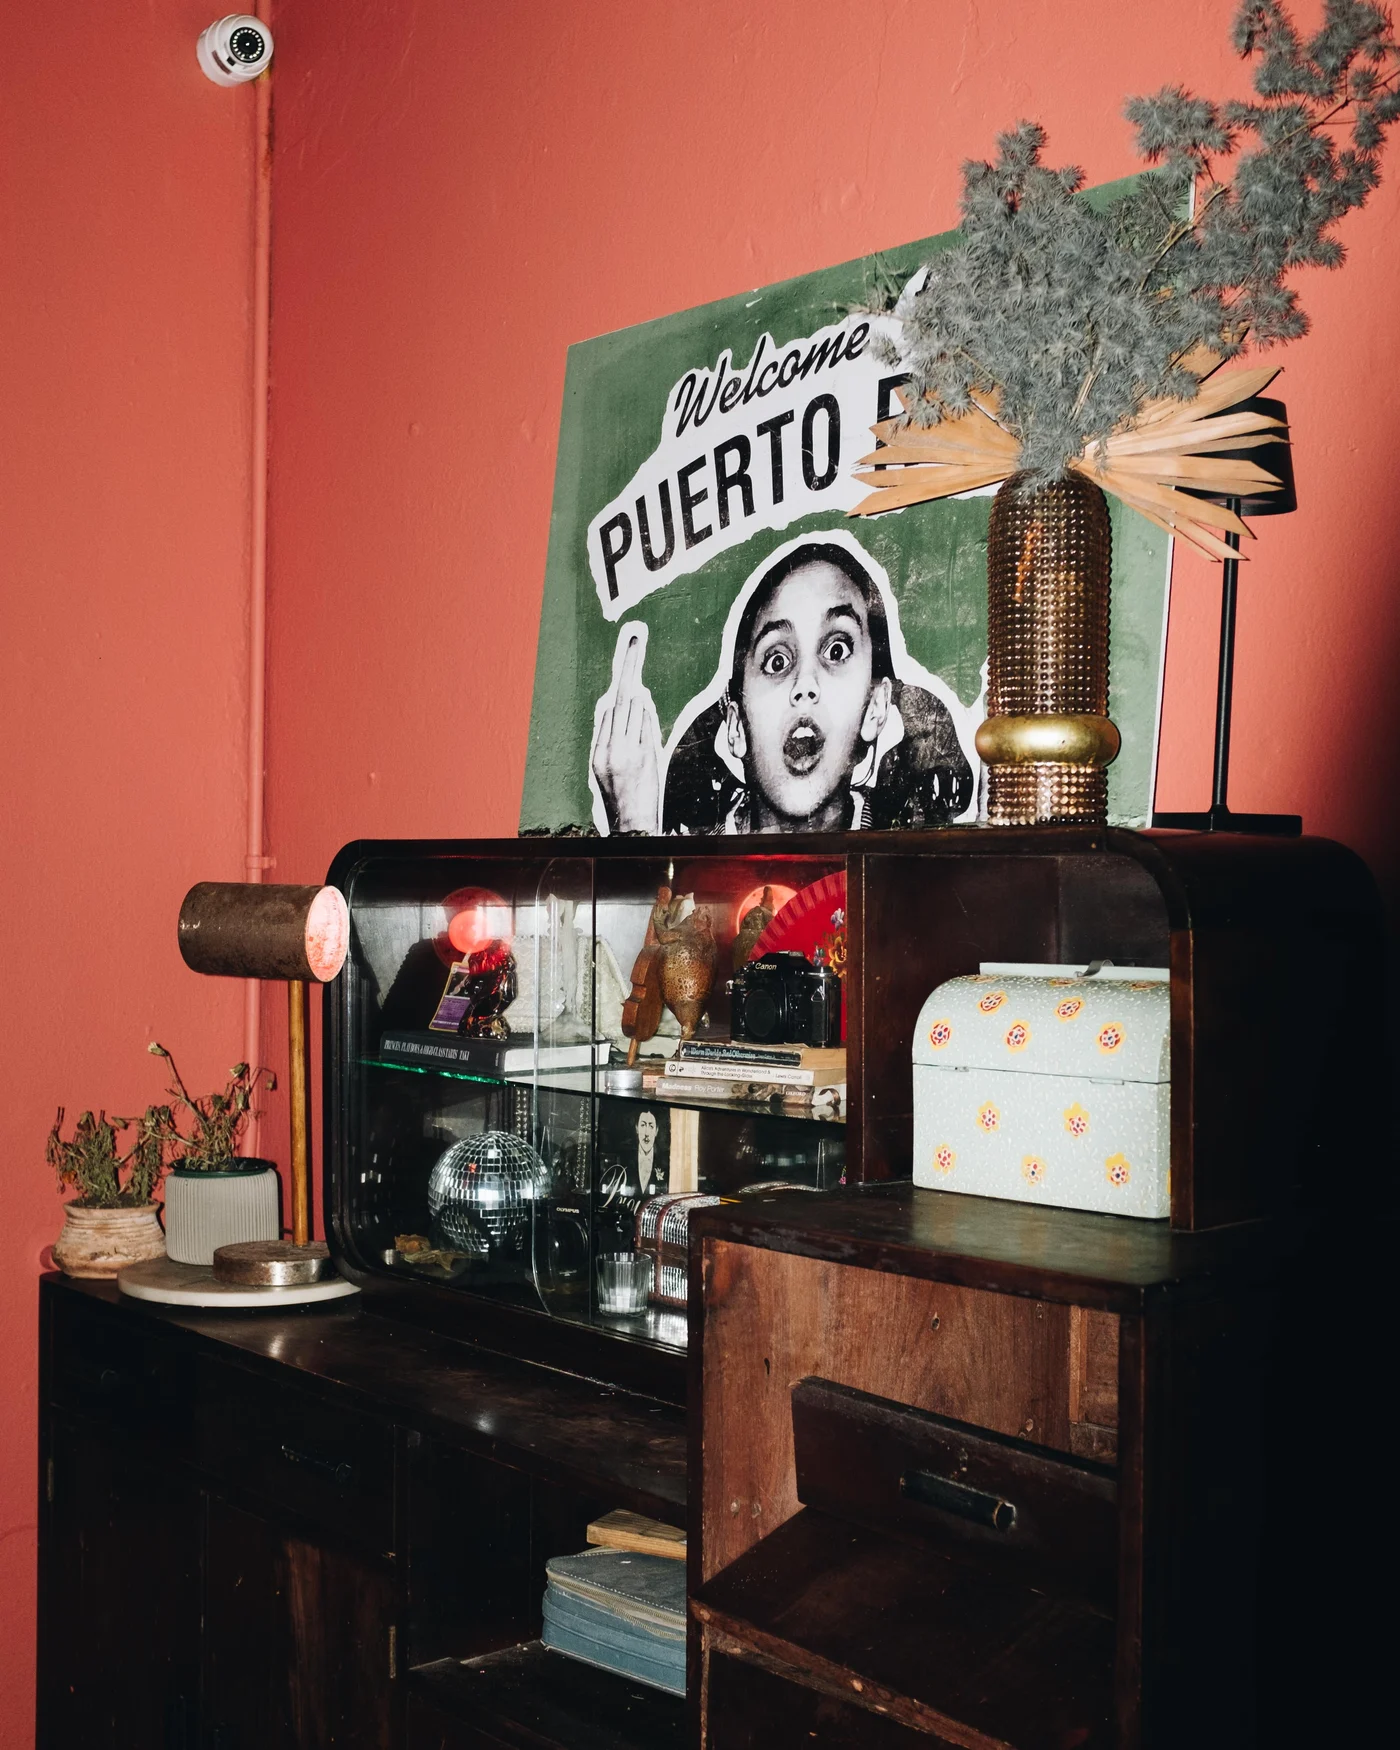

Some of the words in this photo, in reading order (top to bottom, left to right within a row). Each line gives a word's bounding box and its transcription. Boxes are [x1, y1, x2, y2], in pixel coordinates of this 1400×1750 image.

[674, 322, 870, 438] Welcome
[599, 393, 841, 601] PUERTO
[755, 962, 777, 970] Canon
[662, 1083, 692, 1091] Madness
[694, 1085, 705, 1094] Roy
[556, 1206, 580, 1214] OLYMPUS
